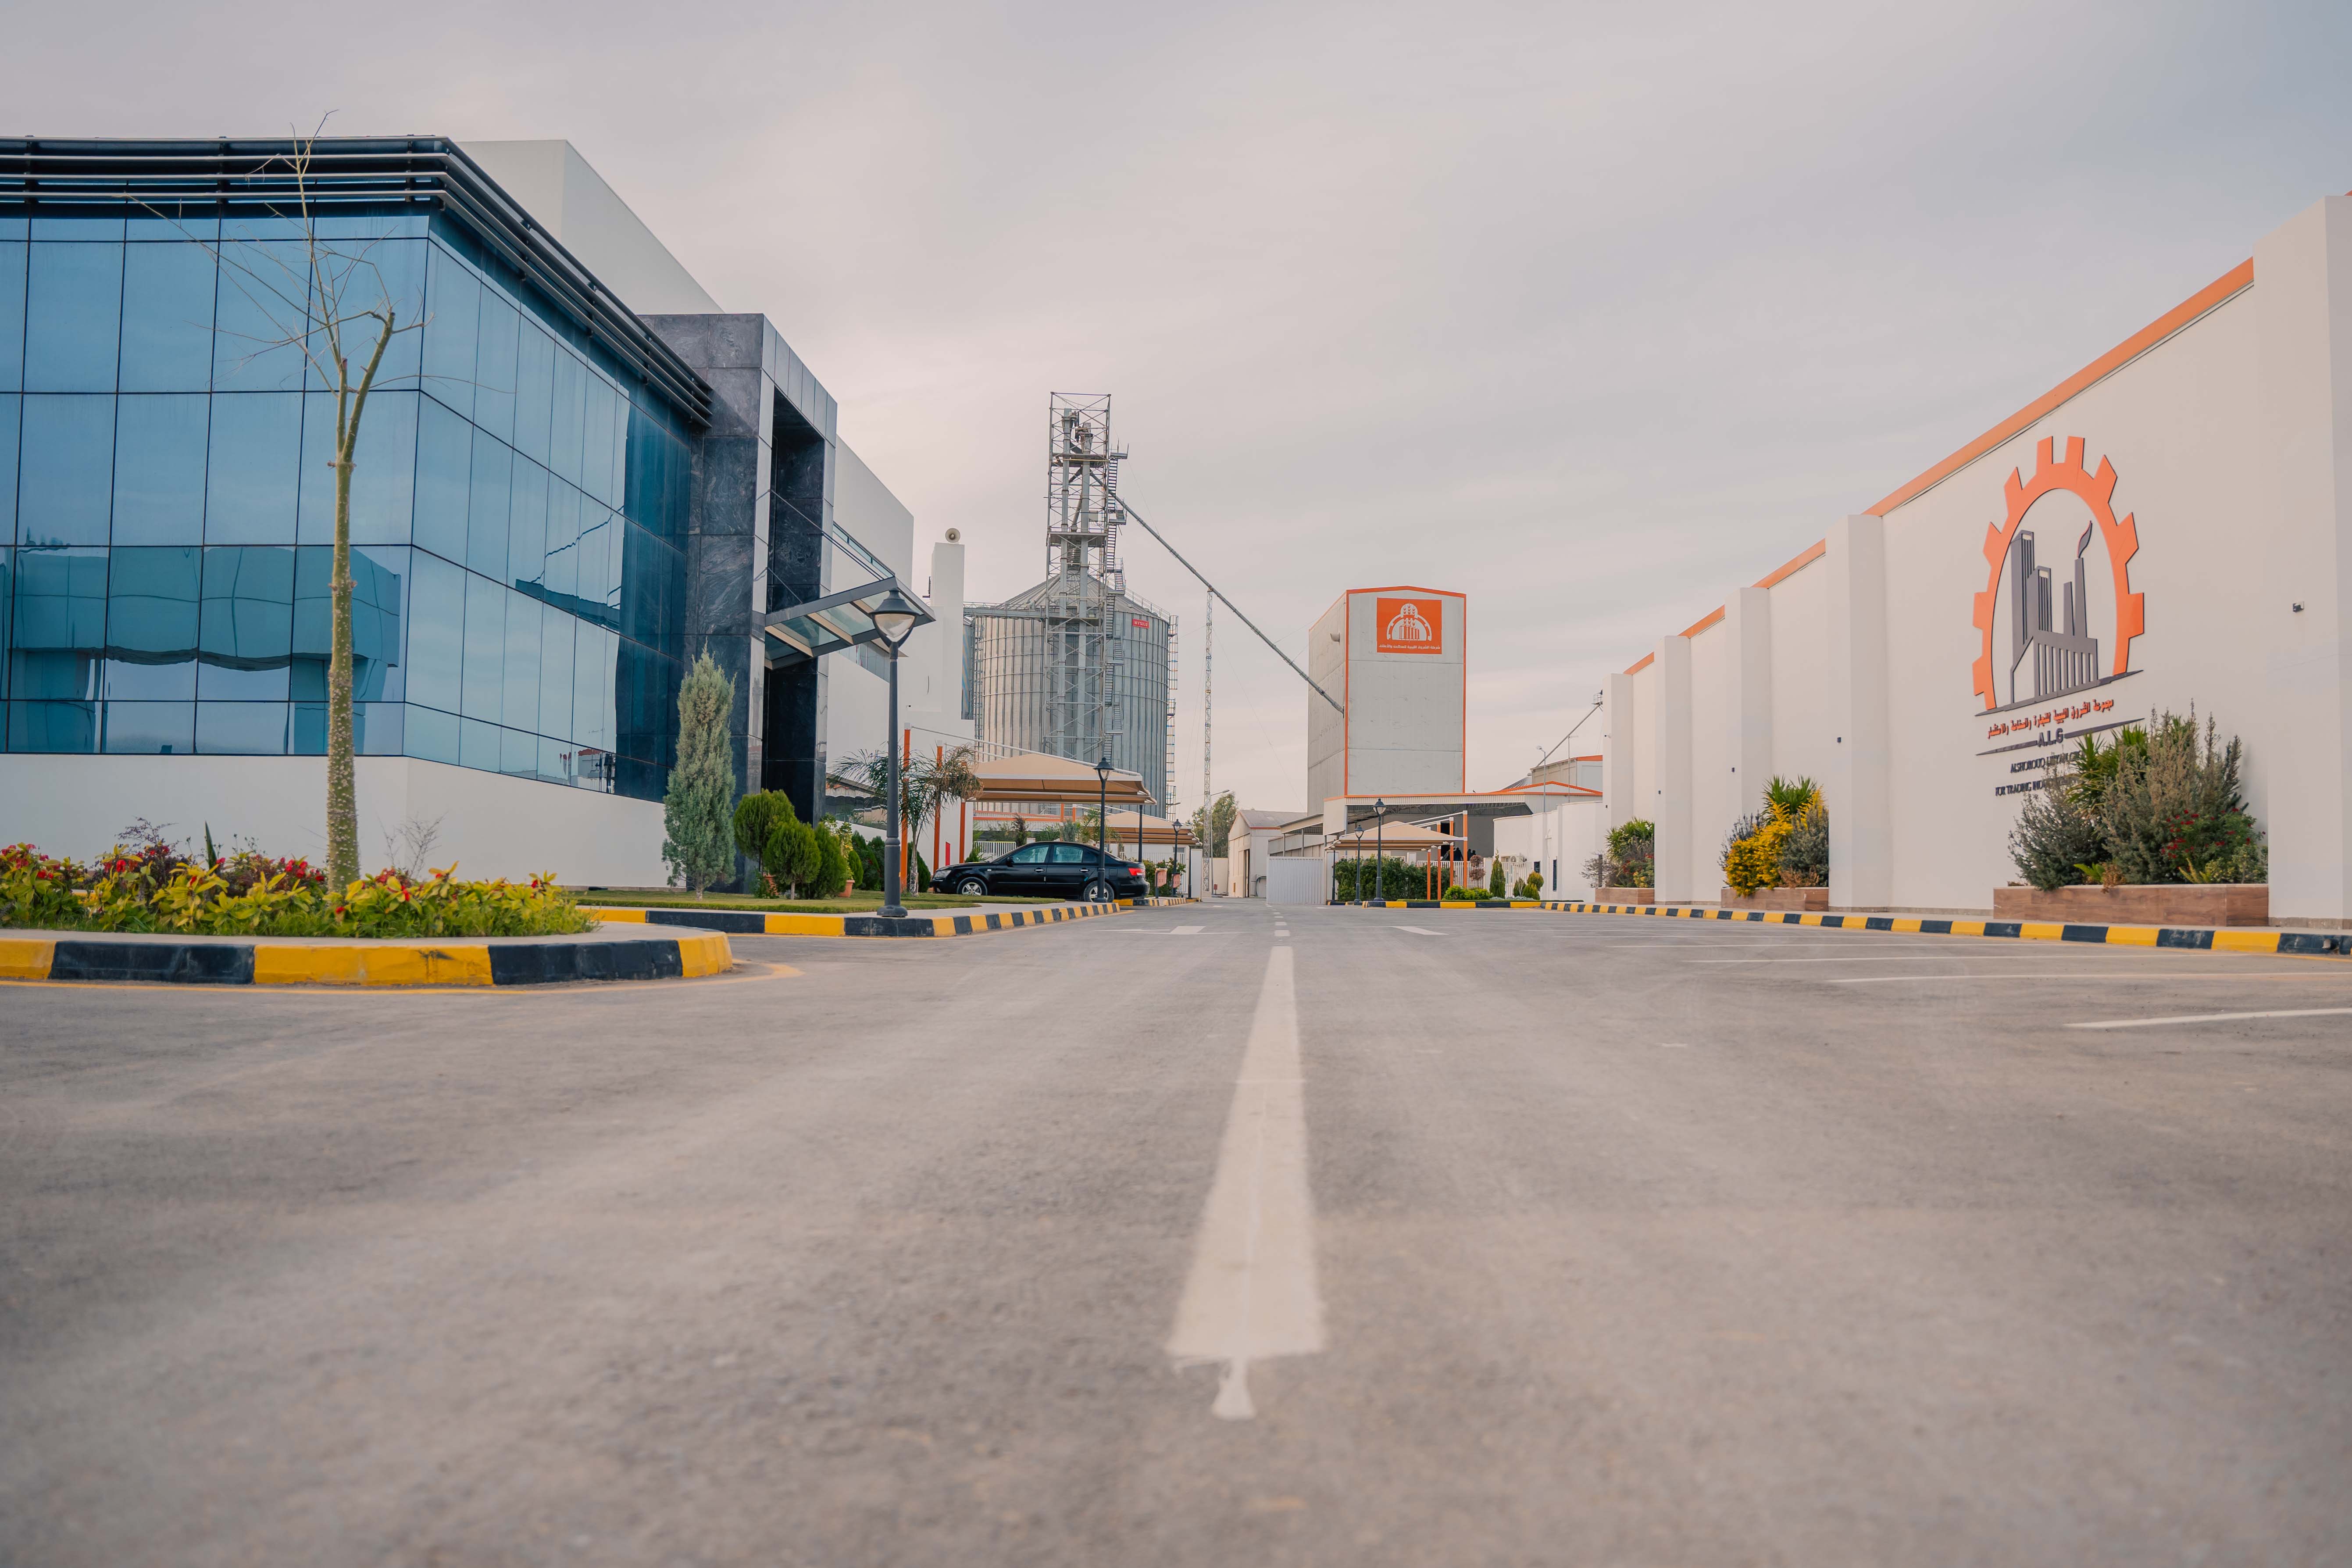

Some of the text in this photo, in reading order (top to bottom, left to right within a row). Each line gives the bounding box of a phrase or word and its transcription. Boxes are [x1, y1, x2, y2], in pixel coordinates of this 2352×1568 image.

[2071, 701, 2090, 719] الشروق
[2092, 699, 2114, 712] مجموعة
[2033, 712, 2051, 728] للتجارة
[2053, 707, 2069, 724] الليبية
[2010, 718, 2031, 731] والصناعة
[2038, 728, 2064, 747] A.L.G
[1995, 786, 2006, 797] FOR
[2006, 782, 2031, 794] TRADING
